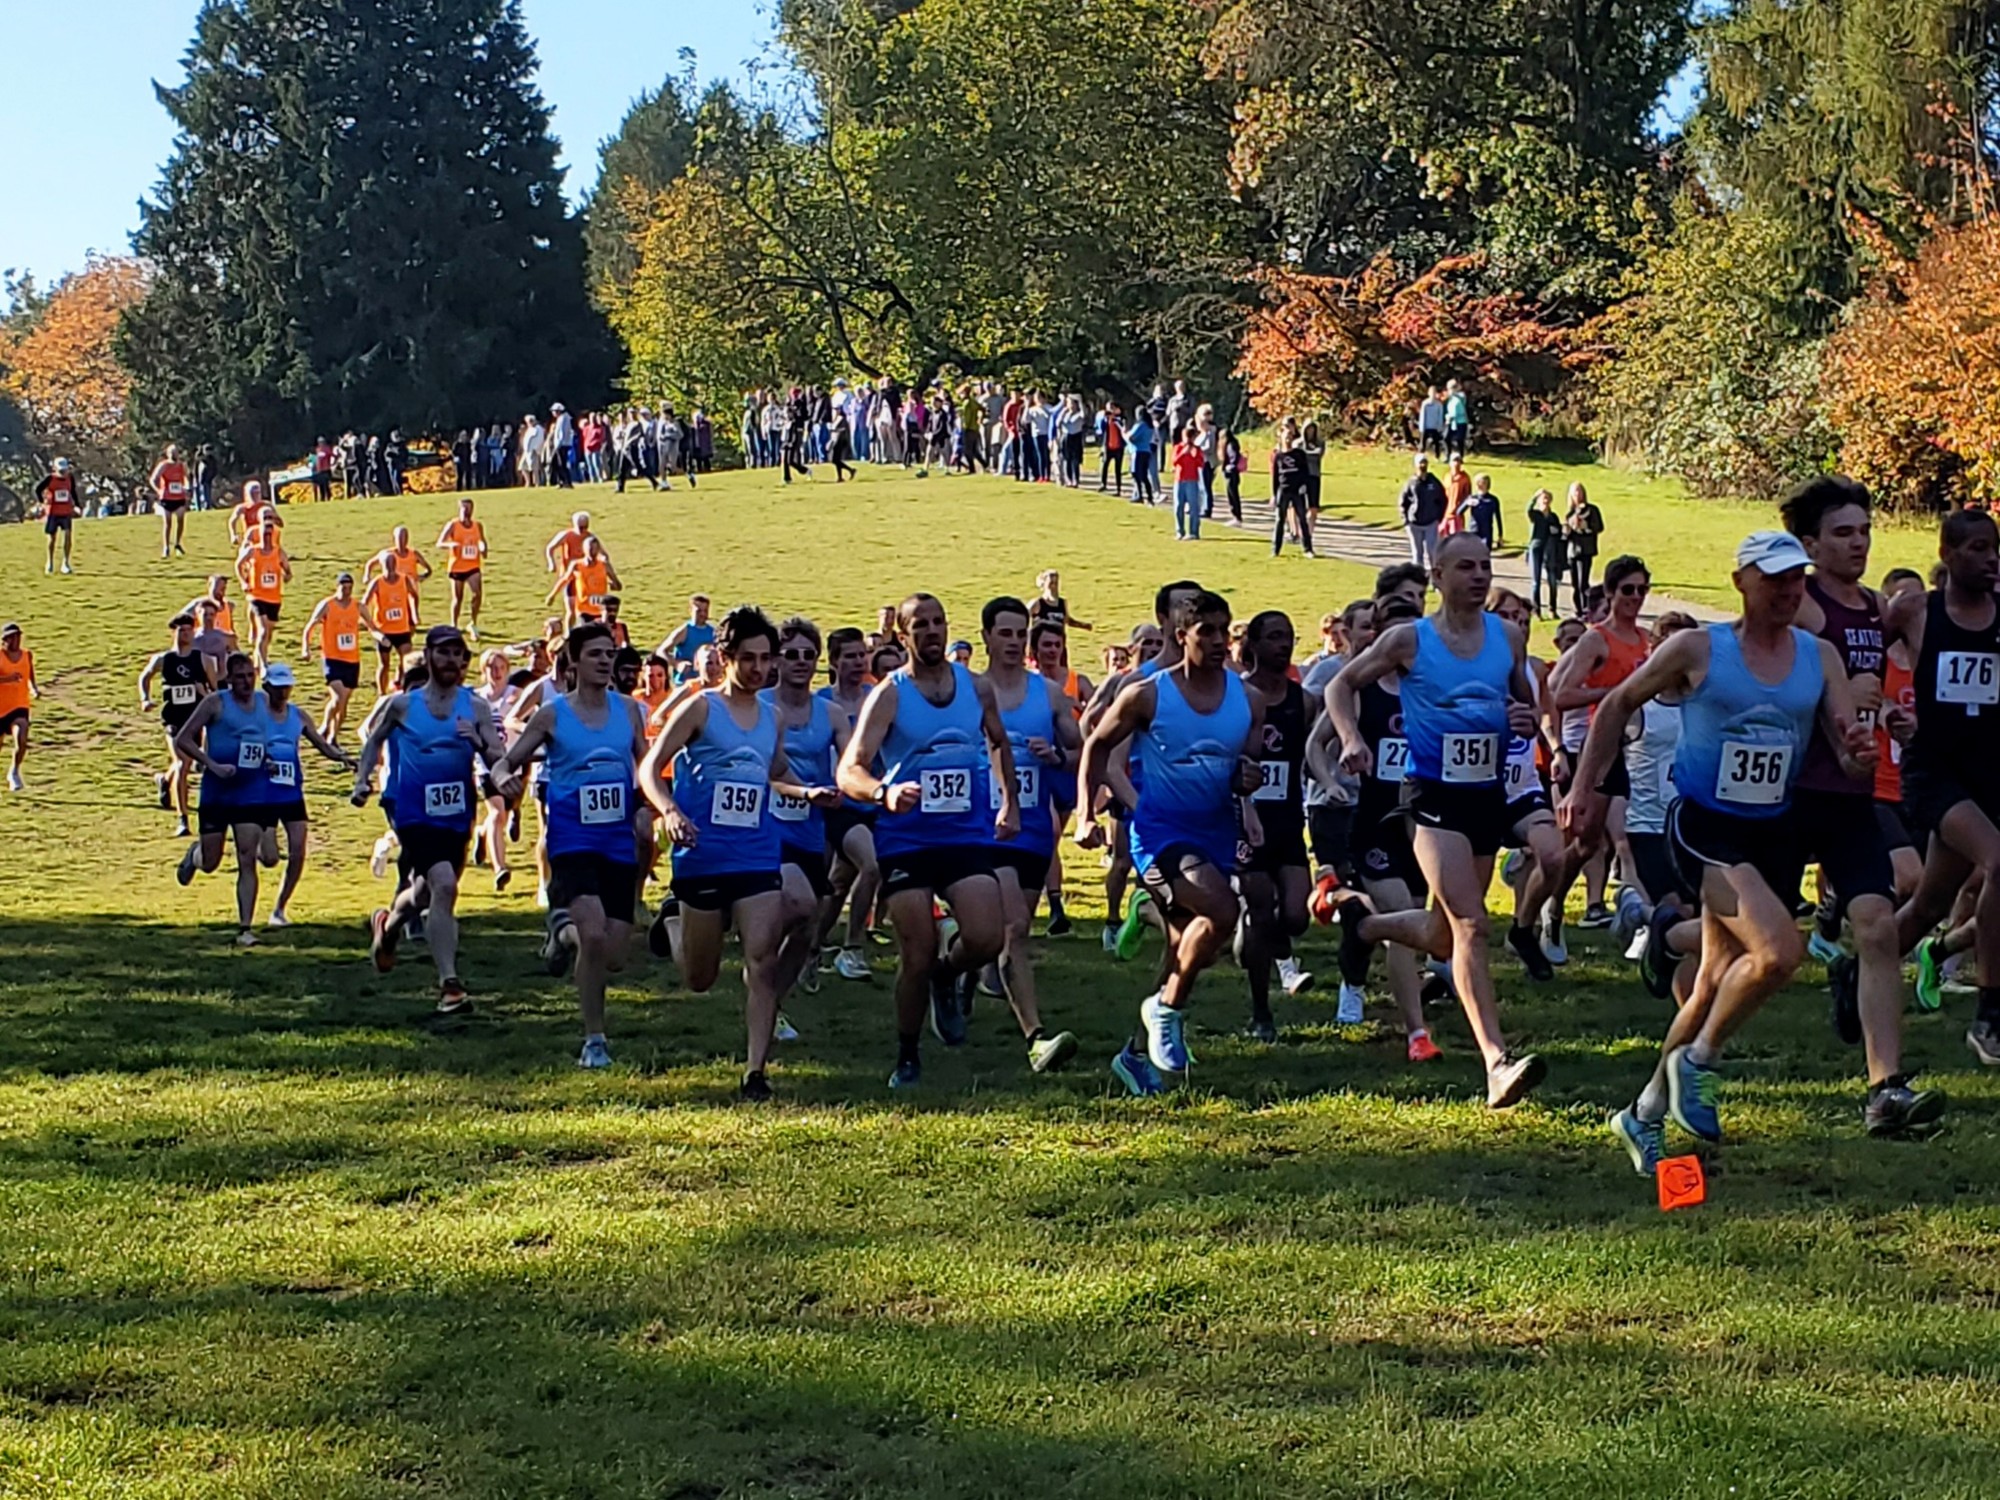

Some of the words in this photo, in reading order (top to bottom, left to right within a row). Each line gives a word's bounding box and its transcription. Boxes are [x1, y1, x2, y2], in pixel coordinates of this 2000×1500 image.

[1947, 657, 1993, 685] 176
[1386, 742, 1407, 767] 27
[1453, 738, 1491, 766] 351
[1260, 764, 1281, 786] 81
[1731, 749, 1784, 784] 356
[431, 785, 460, 806] 362
[587, 787, 621, 811] 360
[721, 785, 758, 813] 359
[929, 773, 966, 799] 352
